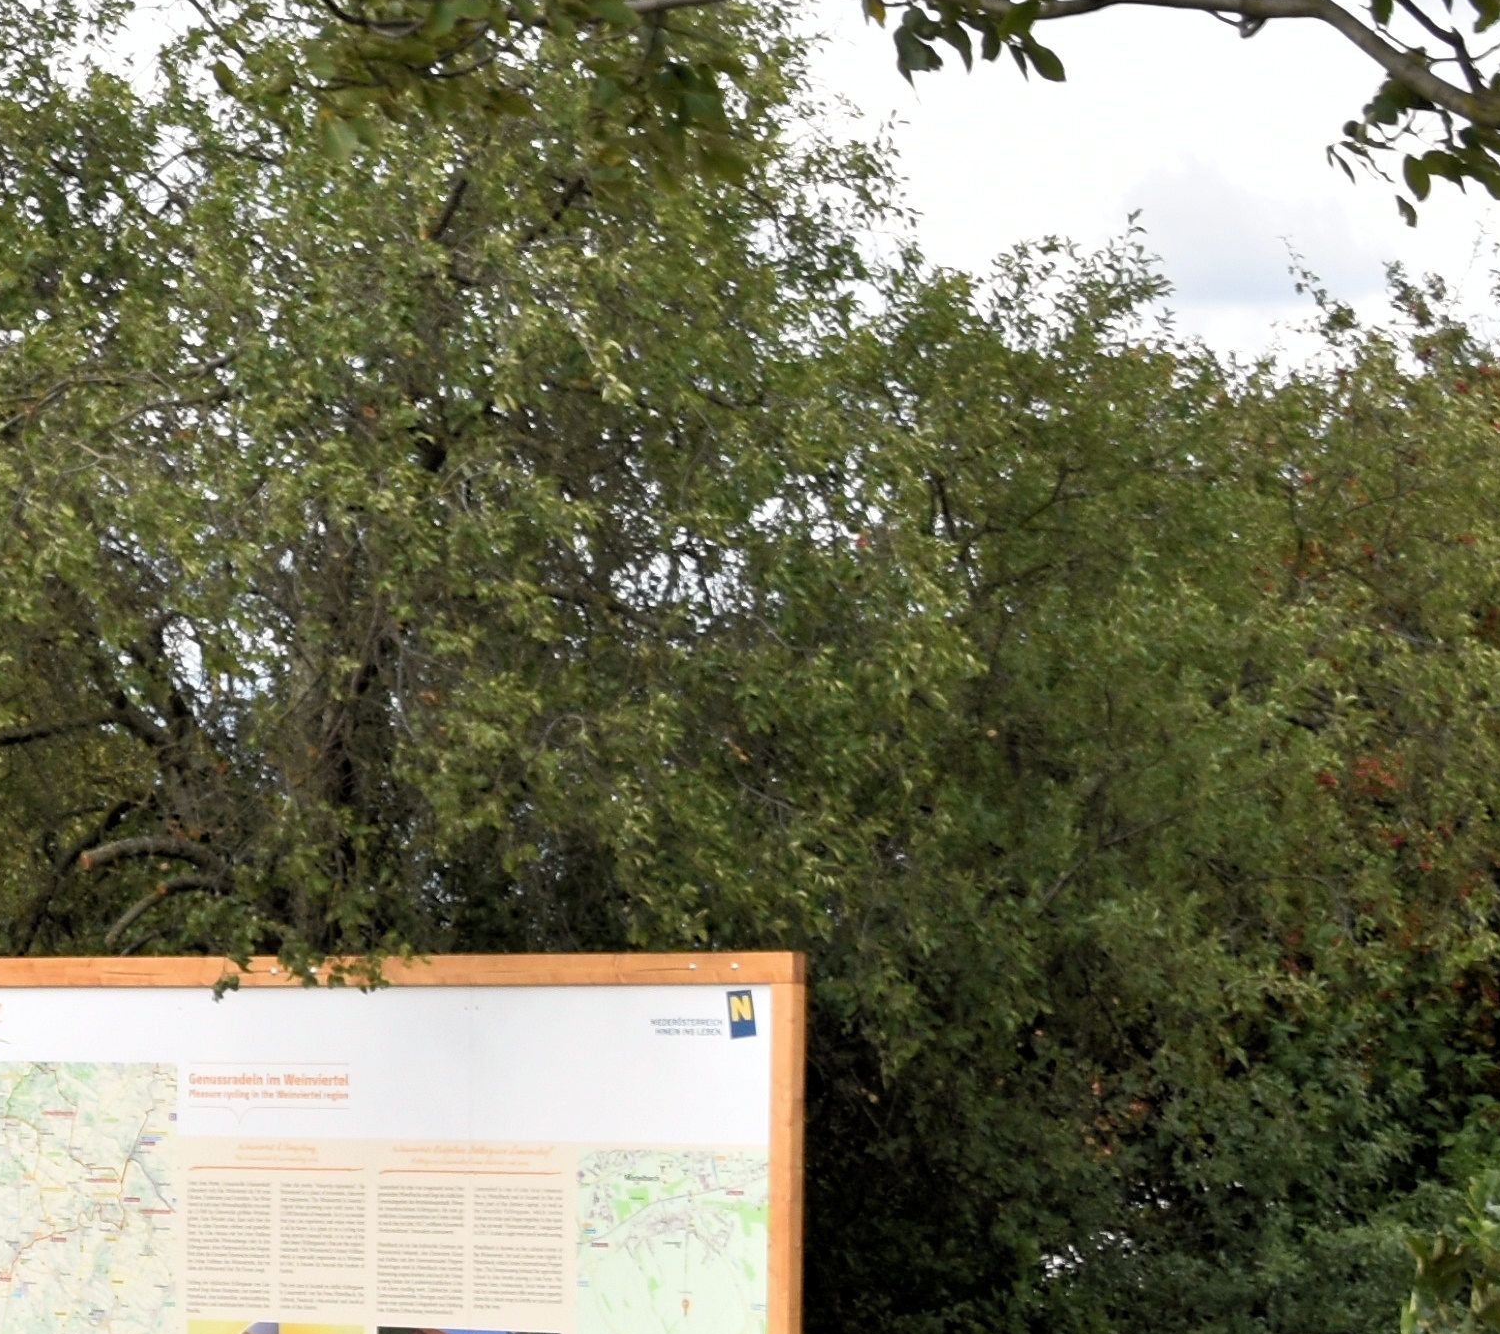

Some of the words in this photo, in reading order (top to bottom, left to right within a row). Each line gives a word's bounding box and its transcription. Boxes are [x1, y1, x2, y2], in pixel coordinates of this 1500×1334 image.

[729, 995, 753, 1022] N
[188, 1072, 264, 1086] Genussradeln
[266, 1073, 281, 1086] im
[283, 1073, 349, 1087] Weinviertel
[188, 1089, 221, 1099] Pleasure
[223, 1089, 249, 1101] cycling
[252, 1090, 260, 1099] in
[261, 1090, 274, 1099] the
[276, 1090, 321, 1100] Weinviertel
[323, 1090, 349, 1101] region
